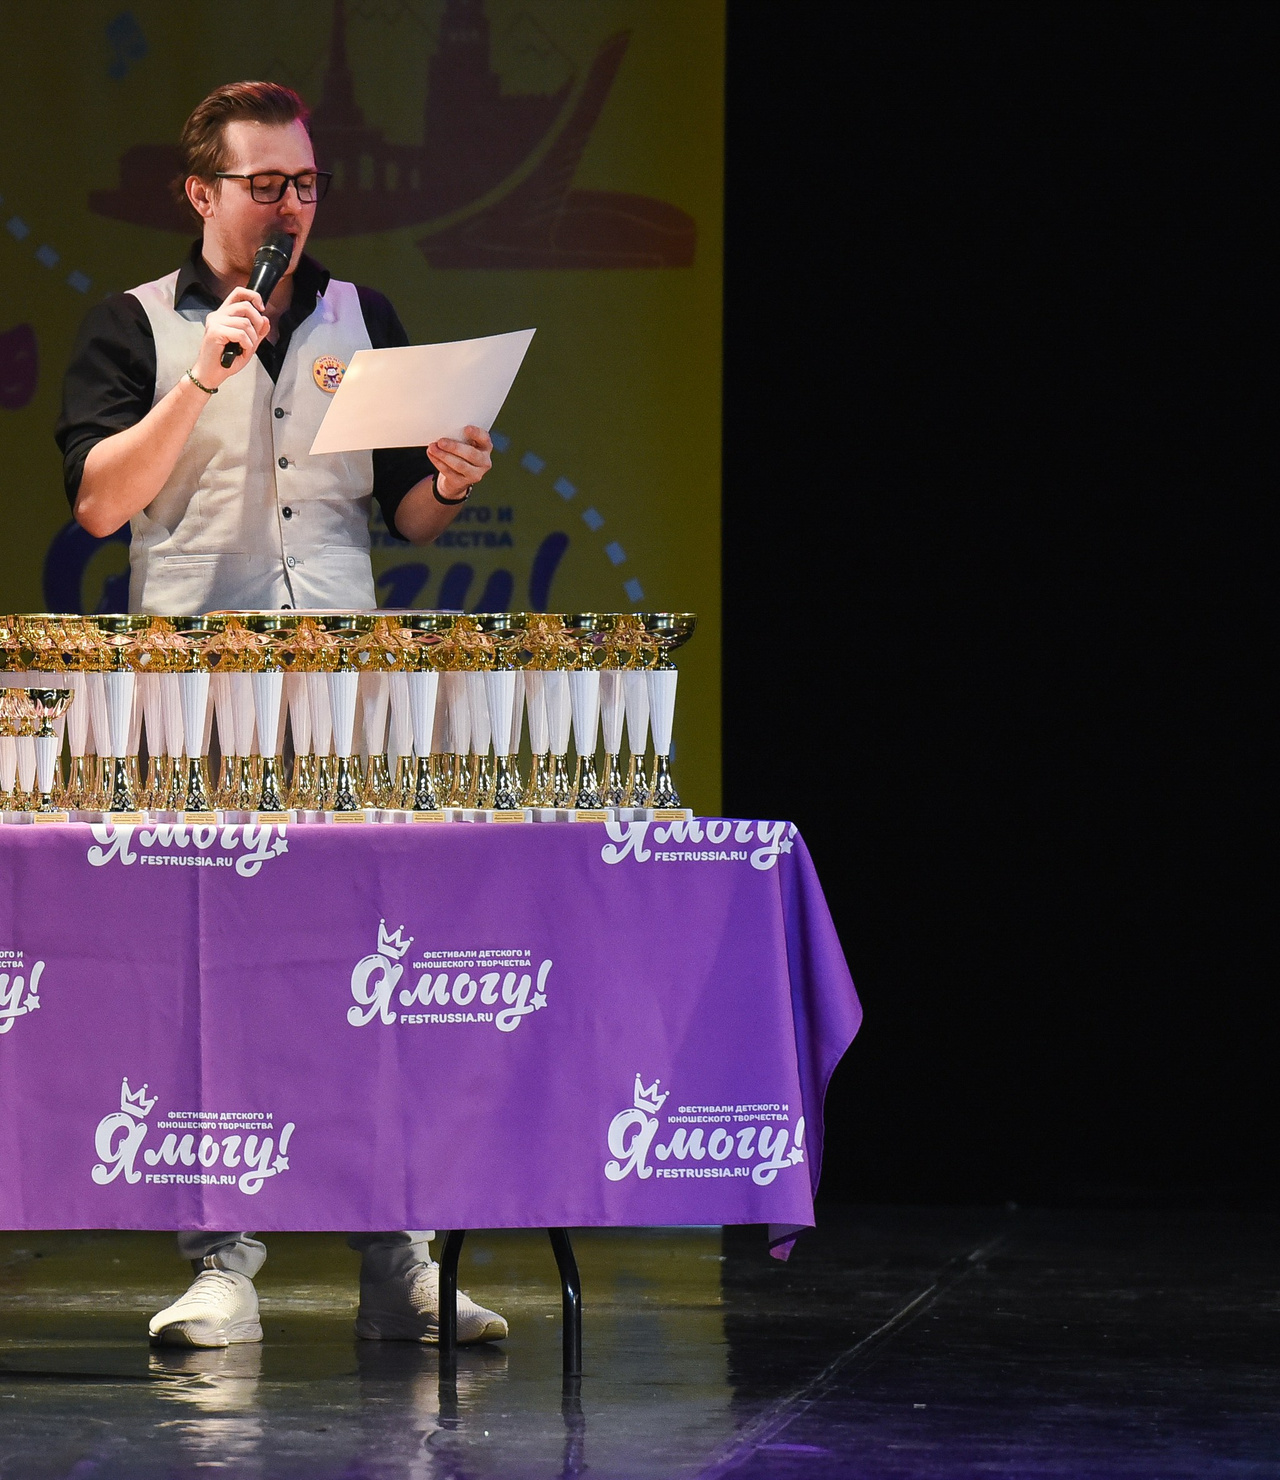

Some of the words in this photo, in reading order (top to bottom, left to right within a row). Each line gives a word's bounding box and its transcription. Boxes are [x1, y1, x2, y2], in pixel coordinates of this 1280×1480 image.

[140, 855, 233, 867] FESTRUSSIA.RU
[654, 851, 748, 862] FESTRUSSIA.RU
[423, 950, 477, 959] ФЕСТИВАЛИ
[478, 949, 523, 958] ДЕТСКОГО
[524, 949, 531, 957] И
[412, 960, 475, 969] ЮНОШЕСКОГО
[476, 959, 531, 968] ТВОРЧЕСТВА
[346, 953, 404, 1027] Я
[399, 959, 553, 1033] могу!
[400, 1012, 494, 1025] FESTRUSSIA.RU
[678, 1105, 734, 1114] ФЕСТИВАЛИ
[735, 1103, 780, 1113] ДЕТСКОГО
[167, 1111, 219, 1120] ФЕСТИВАЛИ
[220, 1112, 264, 1121] ДЕТСКОГО
[667, 1115, 731, 1123] ЮНОШЕСКОГО
[733, 1113, 789, 1122] ТВОРЧЕСТВА
[157, 1121, 216, 1129] ЮНОШЕСКОГО
[218, 1121, 274, 1130] ТВОРЧЕСТВА
[604, 1108, 659, 1182] Я
[654, 1115, 805, 1186] могу!
[91, 1112, 148, 1185] Я
[143, 1122, 296, 1195] могу!
[655, 1167, 750, 1178] FESTRUSSIA.RU
[145, 1174, 237, 1185] FESTRUSSIA.RU
